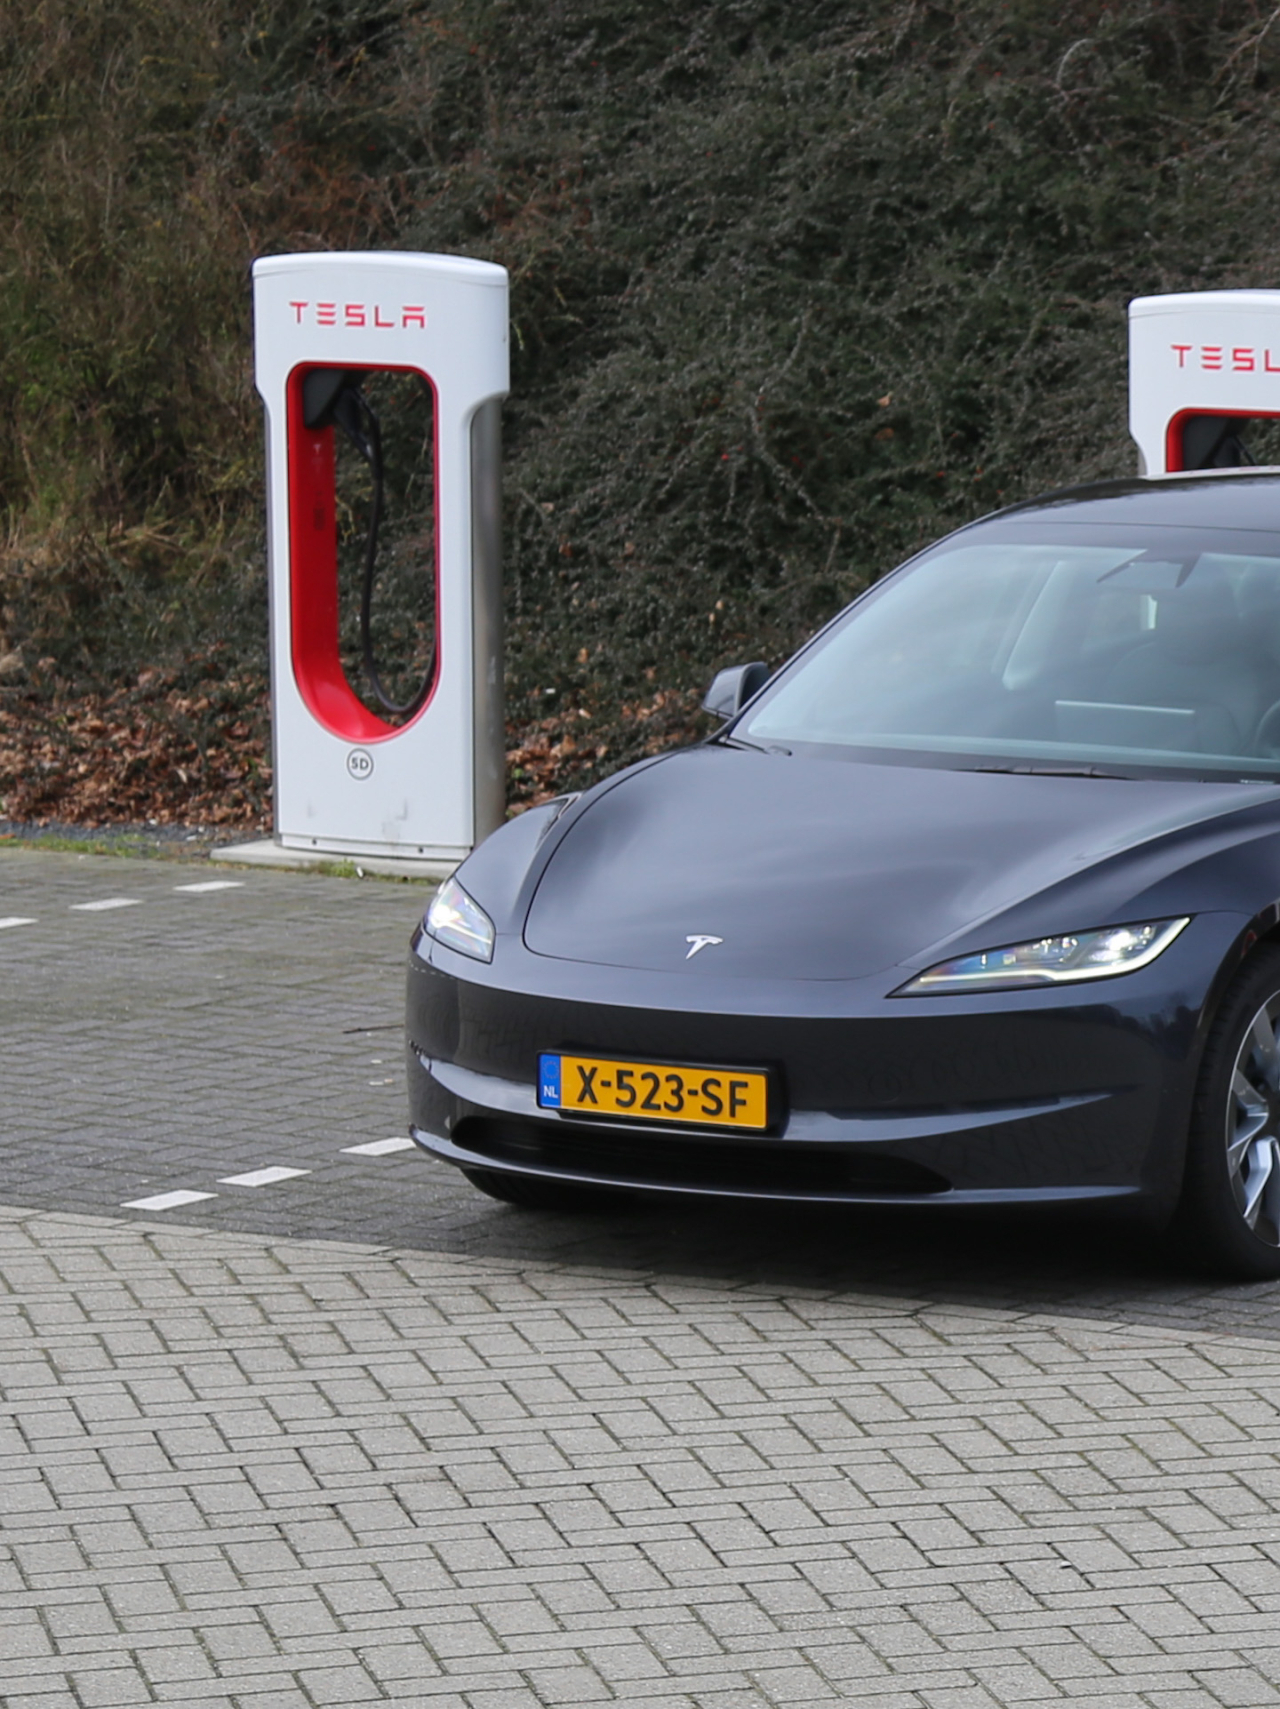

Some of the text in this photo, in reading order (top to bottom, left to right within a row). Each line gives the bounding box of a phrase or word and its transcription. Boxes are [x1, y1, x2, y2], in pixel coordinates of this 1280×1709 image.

[289, 301, 426, 329] TESLA
[351, 757, 369, 770] 5D
[543, 1085, 559, 1099] NL
[576, 1065, 749, 1119] X-523-SF
